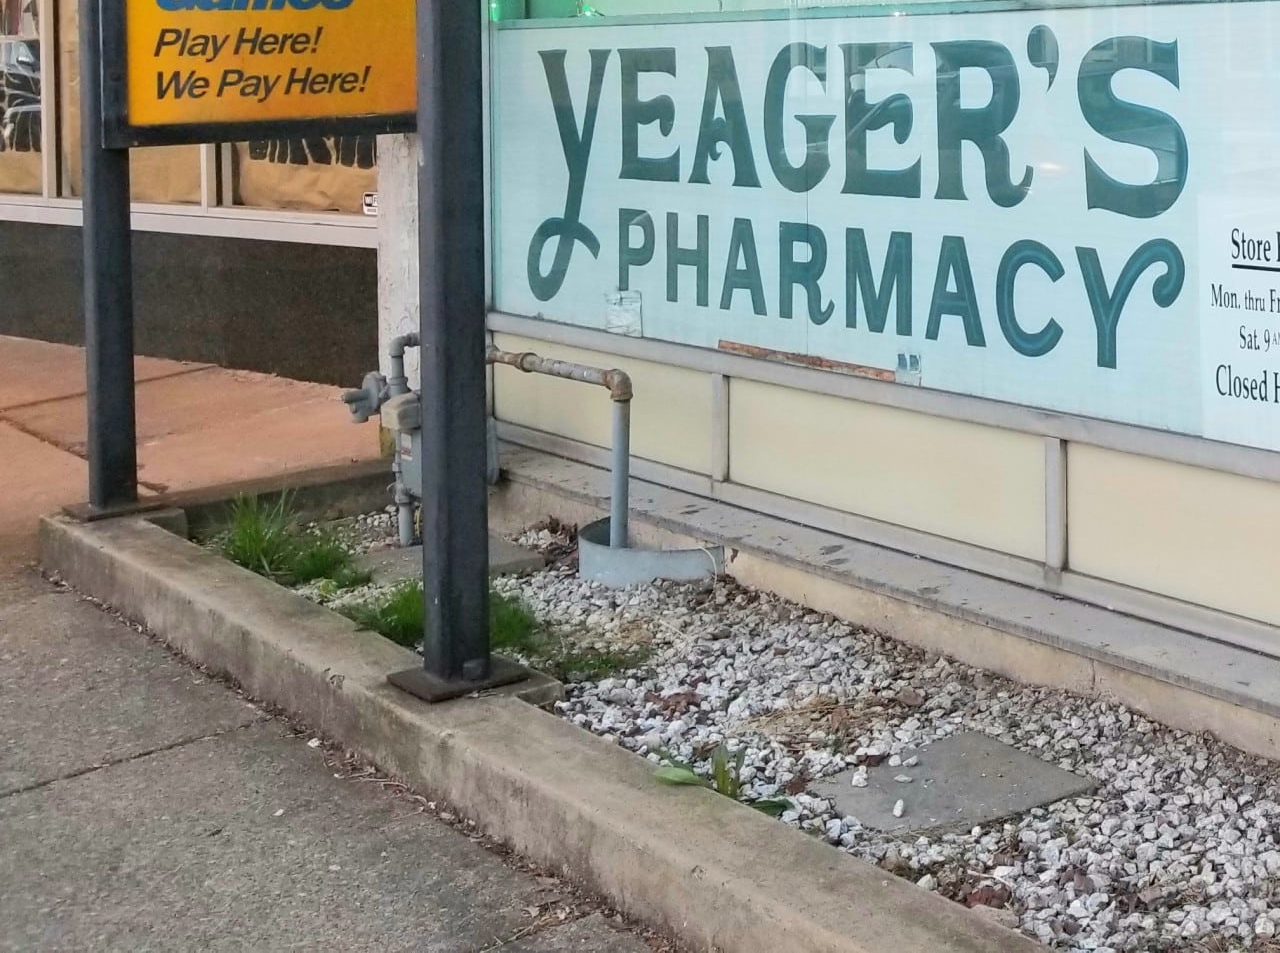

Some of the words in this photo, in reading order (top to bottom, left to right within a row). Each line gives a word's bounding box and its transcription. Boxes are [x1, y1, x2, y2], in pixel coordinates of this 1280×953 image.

[154, 27, 230, 63] Play
[233, 26, 323, 55] Here!
[156, 70, 209, 100] We
[216, 69, 281, 103] Pay
[284, 65, 371, 95] Here!
[526, 23, 1190, 301] YEAGER'S
[1231, 228, 1271, 262] Store
[618, 208, 1187, 369] PHARMACY
[1211, 283, 1240, 309] Mon.
[1244, 290, 1265, 312] thru
[1239, 325, 1260, 350] Sat.
[1216, 364, 1268, 402] Closed
